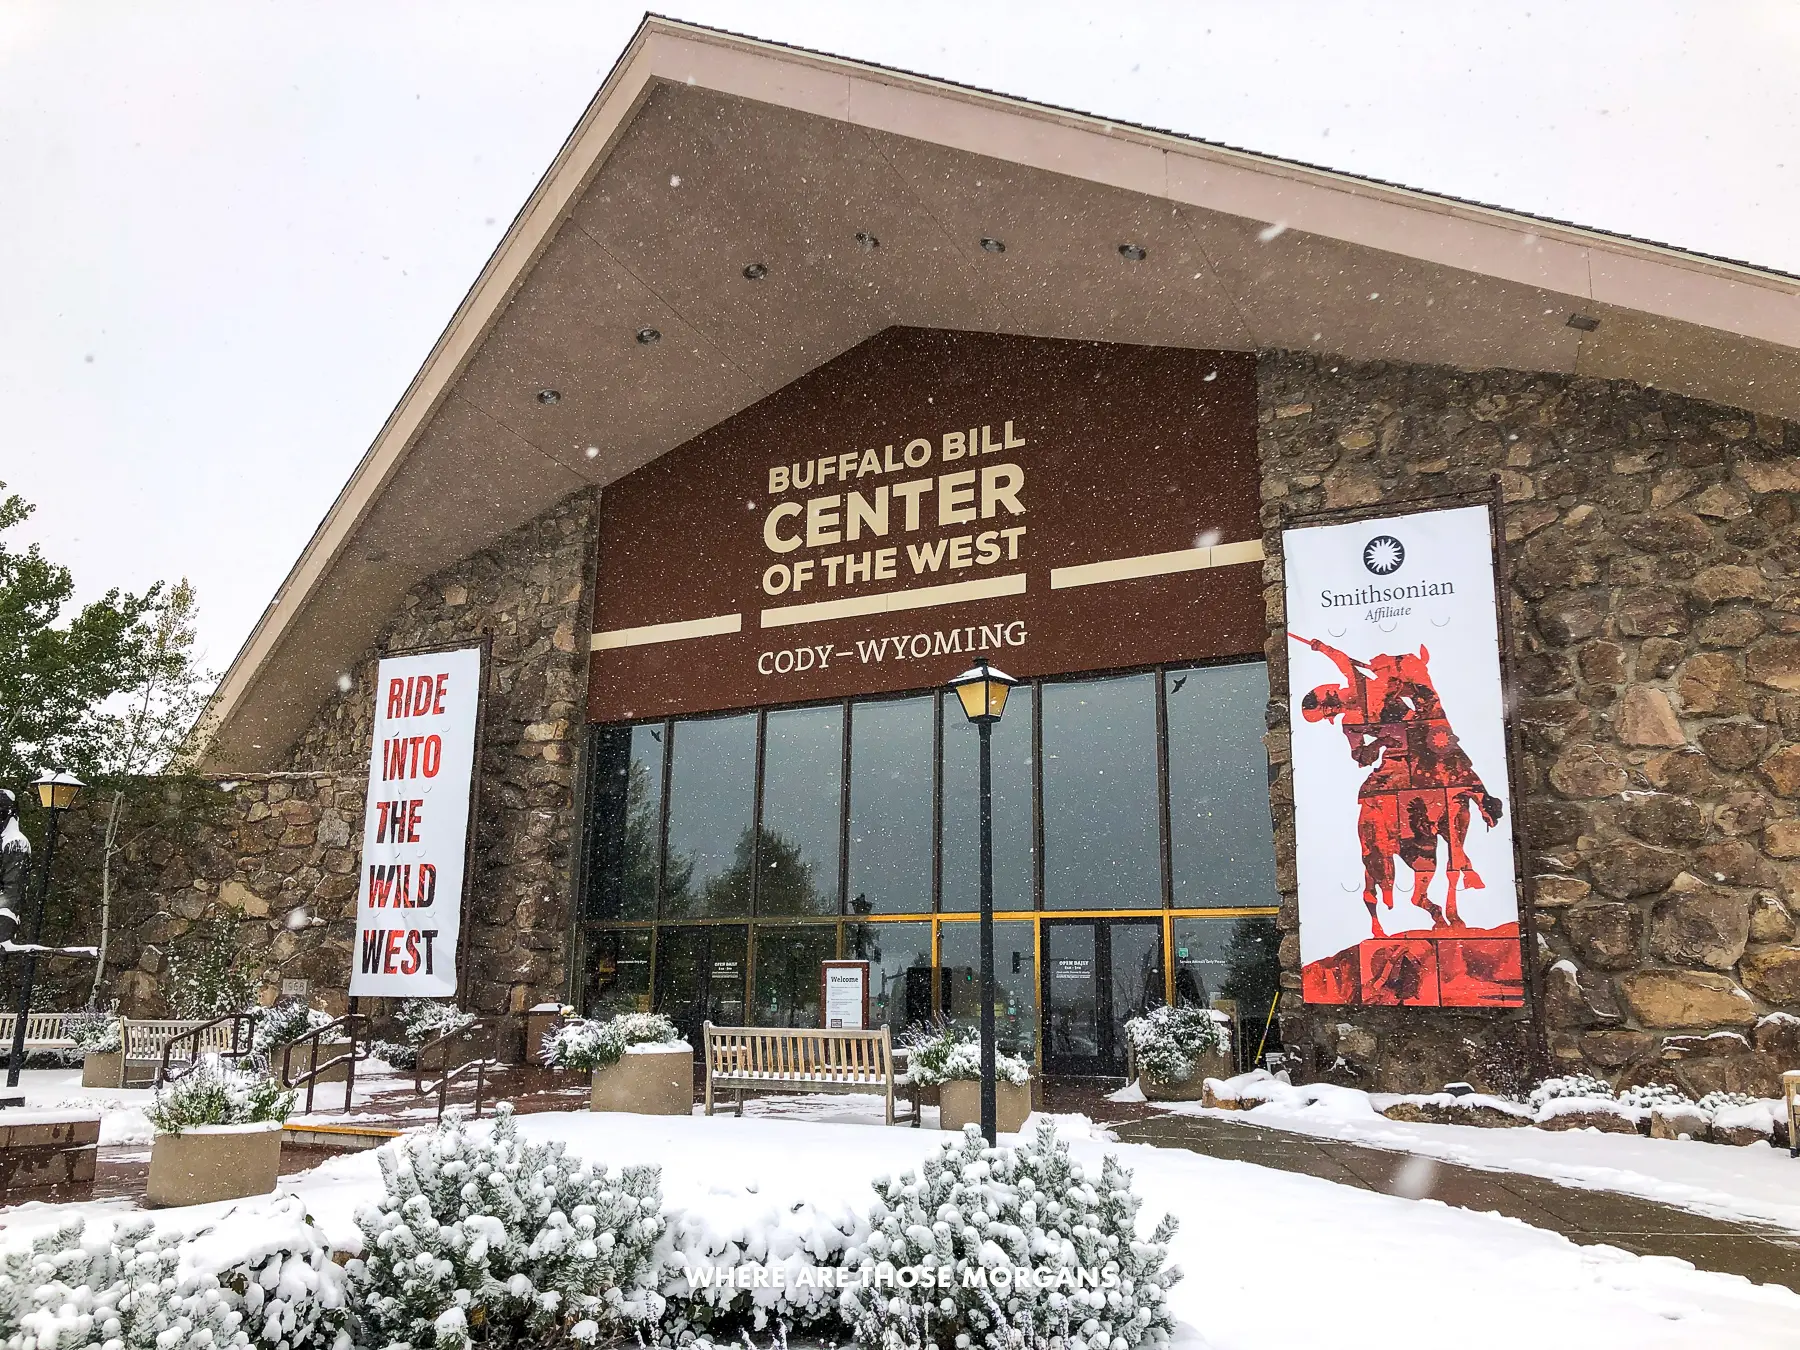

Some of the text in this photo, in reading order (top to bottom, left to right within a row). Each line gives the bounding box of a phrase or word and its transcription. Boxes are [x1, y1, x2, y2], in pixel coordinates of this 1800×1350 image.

[768, 420, 1026, 494] BUFFALO BILL
[763, 463, 1027, 554] CENTER
[762, 526, 1027, 596] OF THE WEST
[1321, 579, 1455, 608] Smithsonian
[1364, 606, 1412, 624] Affiliate
[387, 672, 449, 720] RIDE
[382, 734, 442, 782] INTO
[376, 798, 424, 844] THE
[368, 863, 437, 909] WILD
[361, 929, 438, 975] WEST
